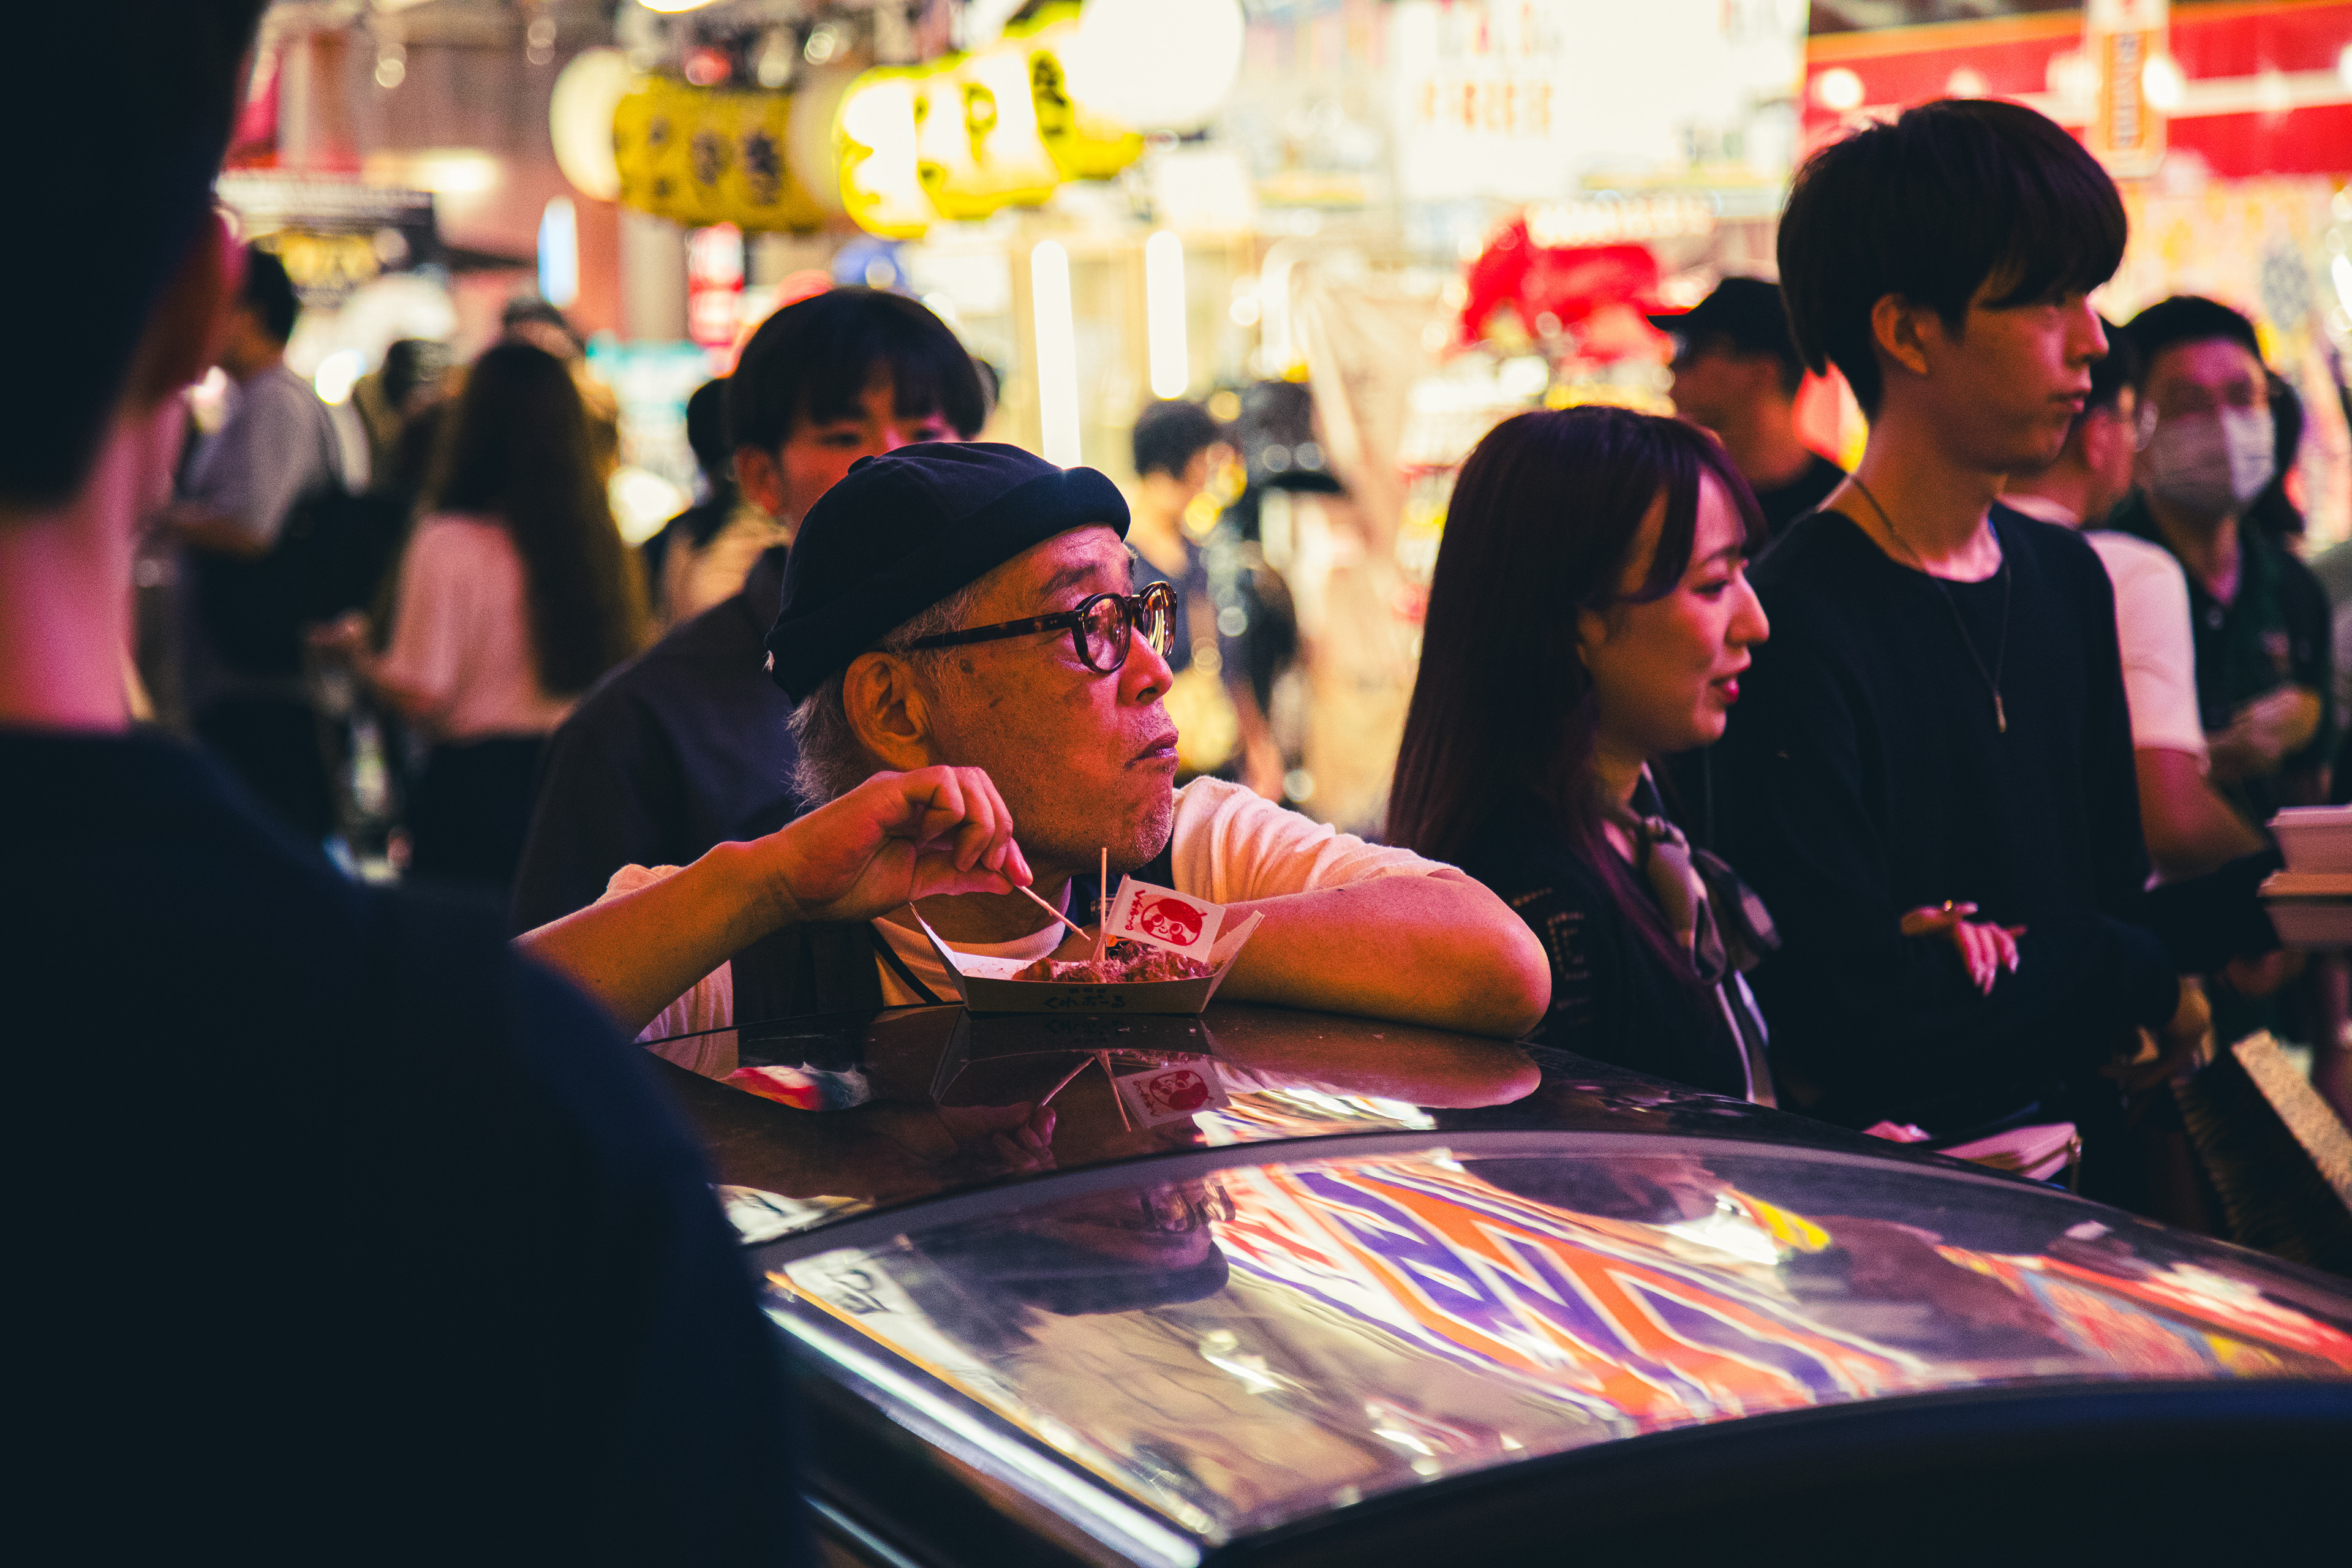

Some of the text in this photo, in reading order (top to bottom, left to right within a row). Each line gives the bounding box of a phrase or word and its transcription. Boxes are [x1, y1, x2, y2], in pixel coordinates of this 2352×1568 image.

[1125, 889, 1147, 931] くれおーる
[1043, 994, 1126, 1009] くれおーる
